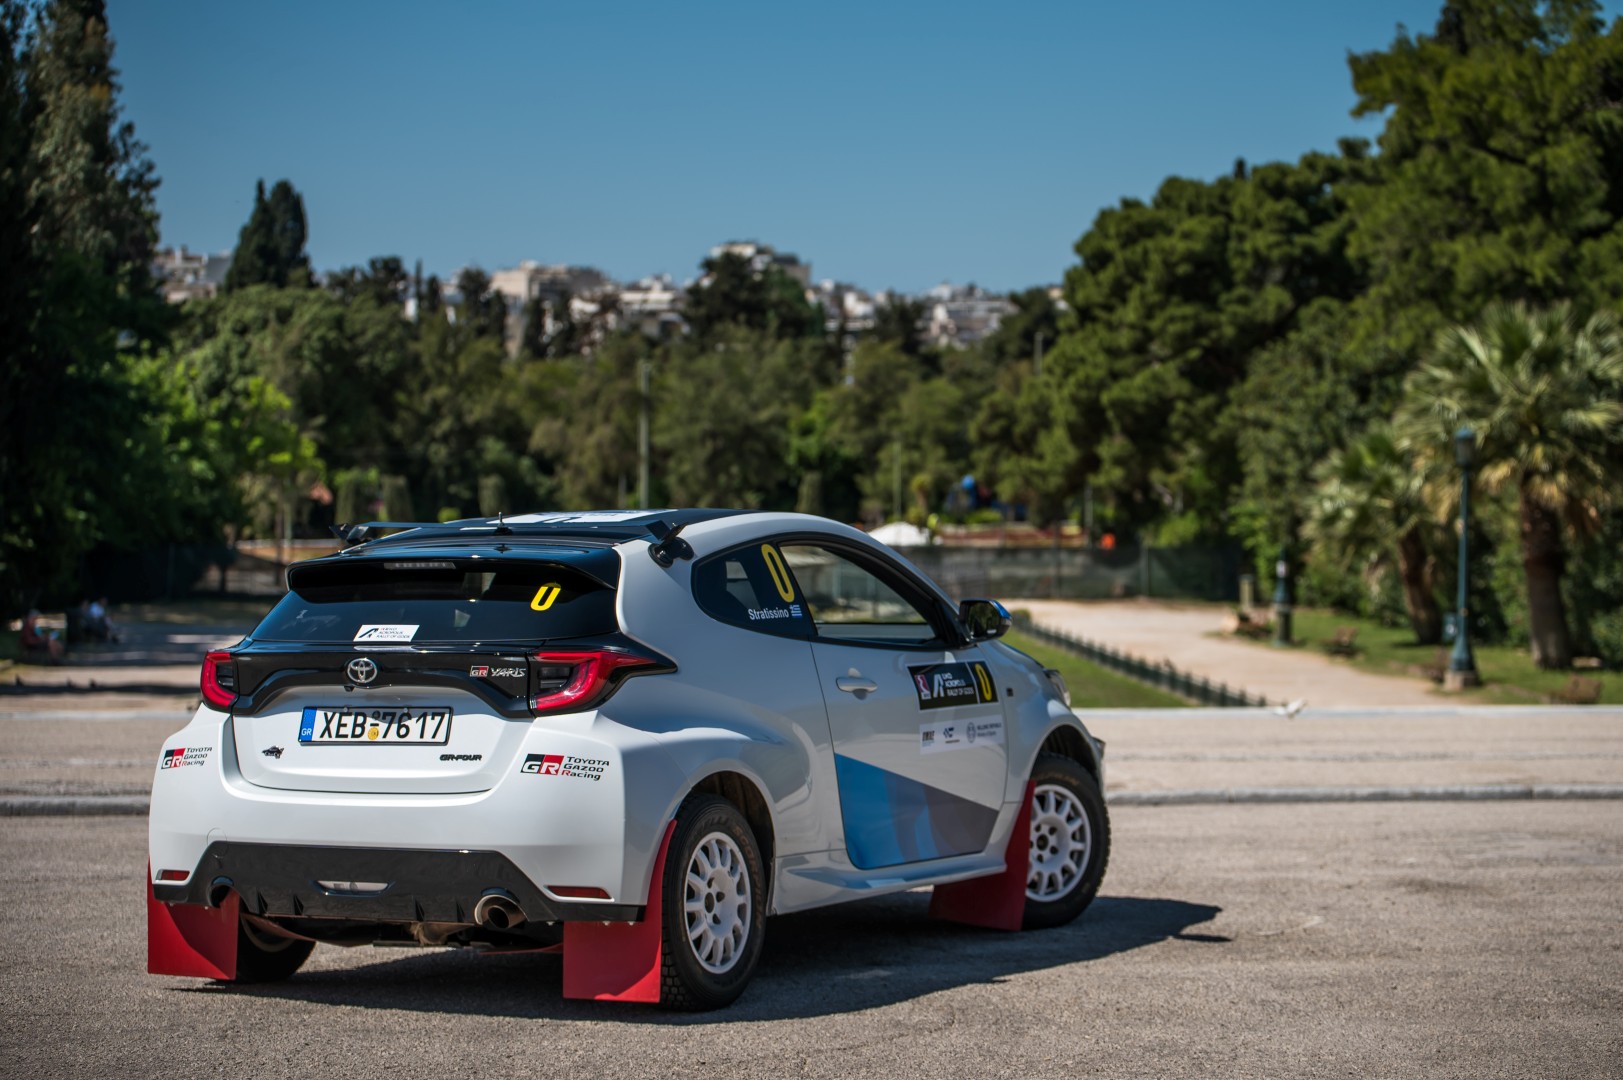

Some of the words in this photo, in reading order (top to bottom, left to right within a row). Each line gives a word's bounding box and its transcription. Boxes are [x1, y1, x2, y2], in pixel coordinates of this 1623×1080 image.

[761, 543, 795, 603] 0
[747, 607, 790, 620] Stratissino
[490, 667, 527, 678] YARIS
[974, 663, 993, 701] 0
[301, 728, 312, 736] GR
[161, 755, 183, 769] GR
[567, 756, 610, 767] TOYOTA
[522, 761, 561, 776] GR
[563, 763, 604, 773] GAZOO
[561, 769, 601, 781] Racing
